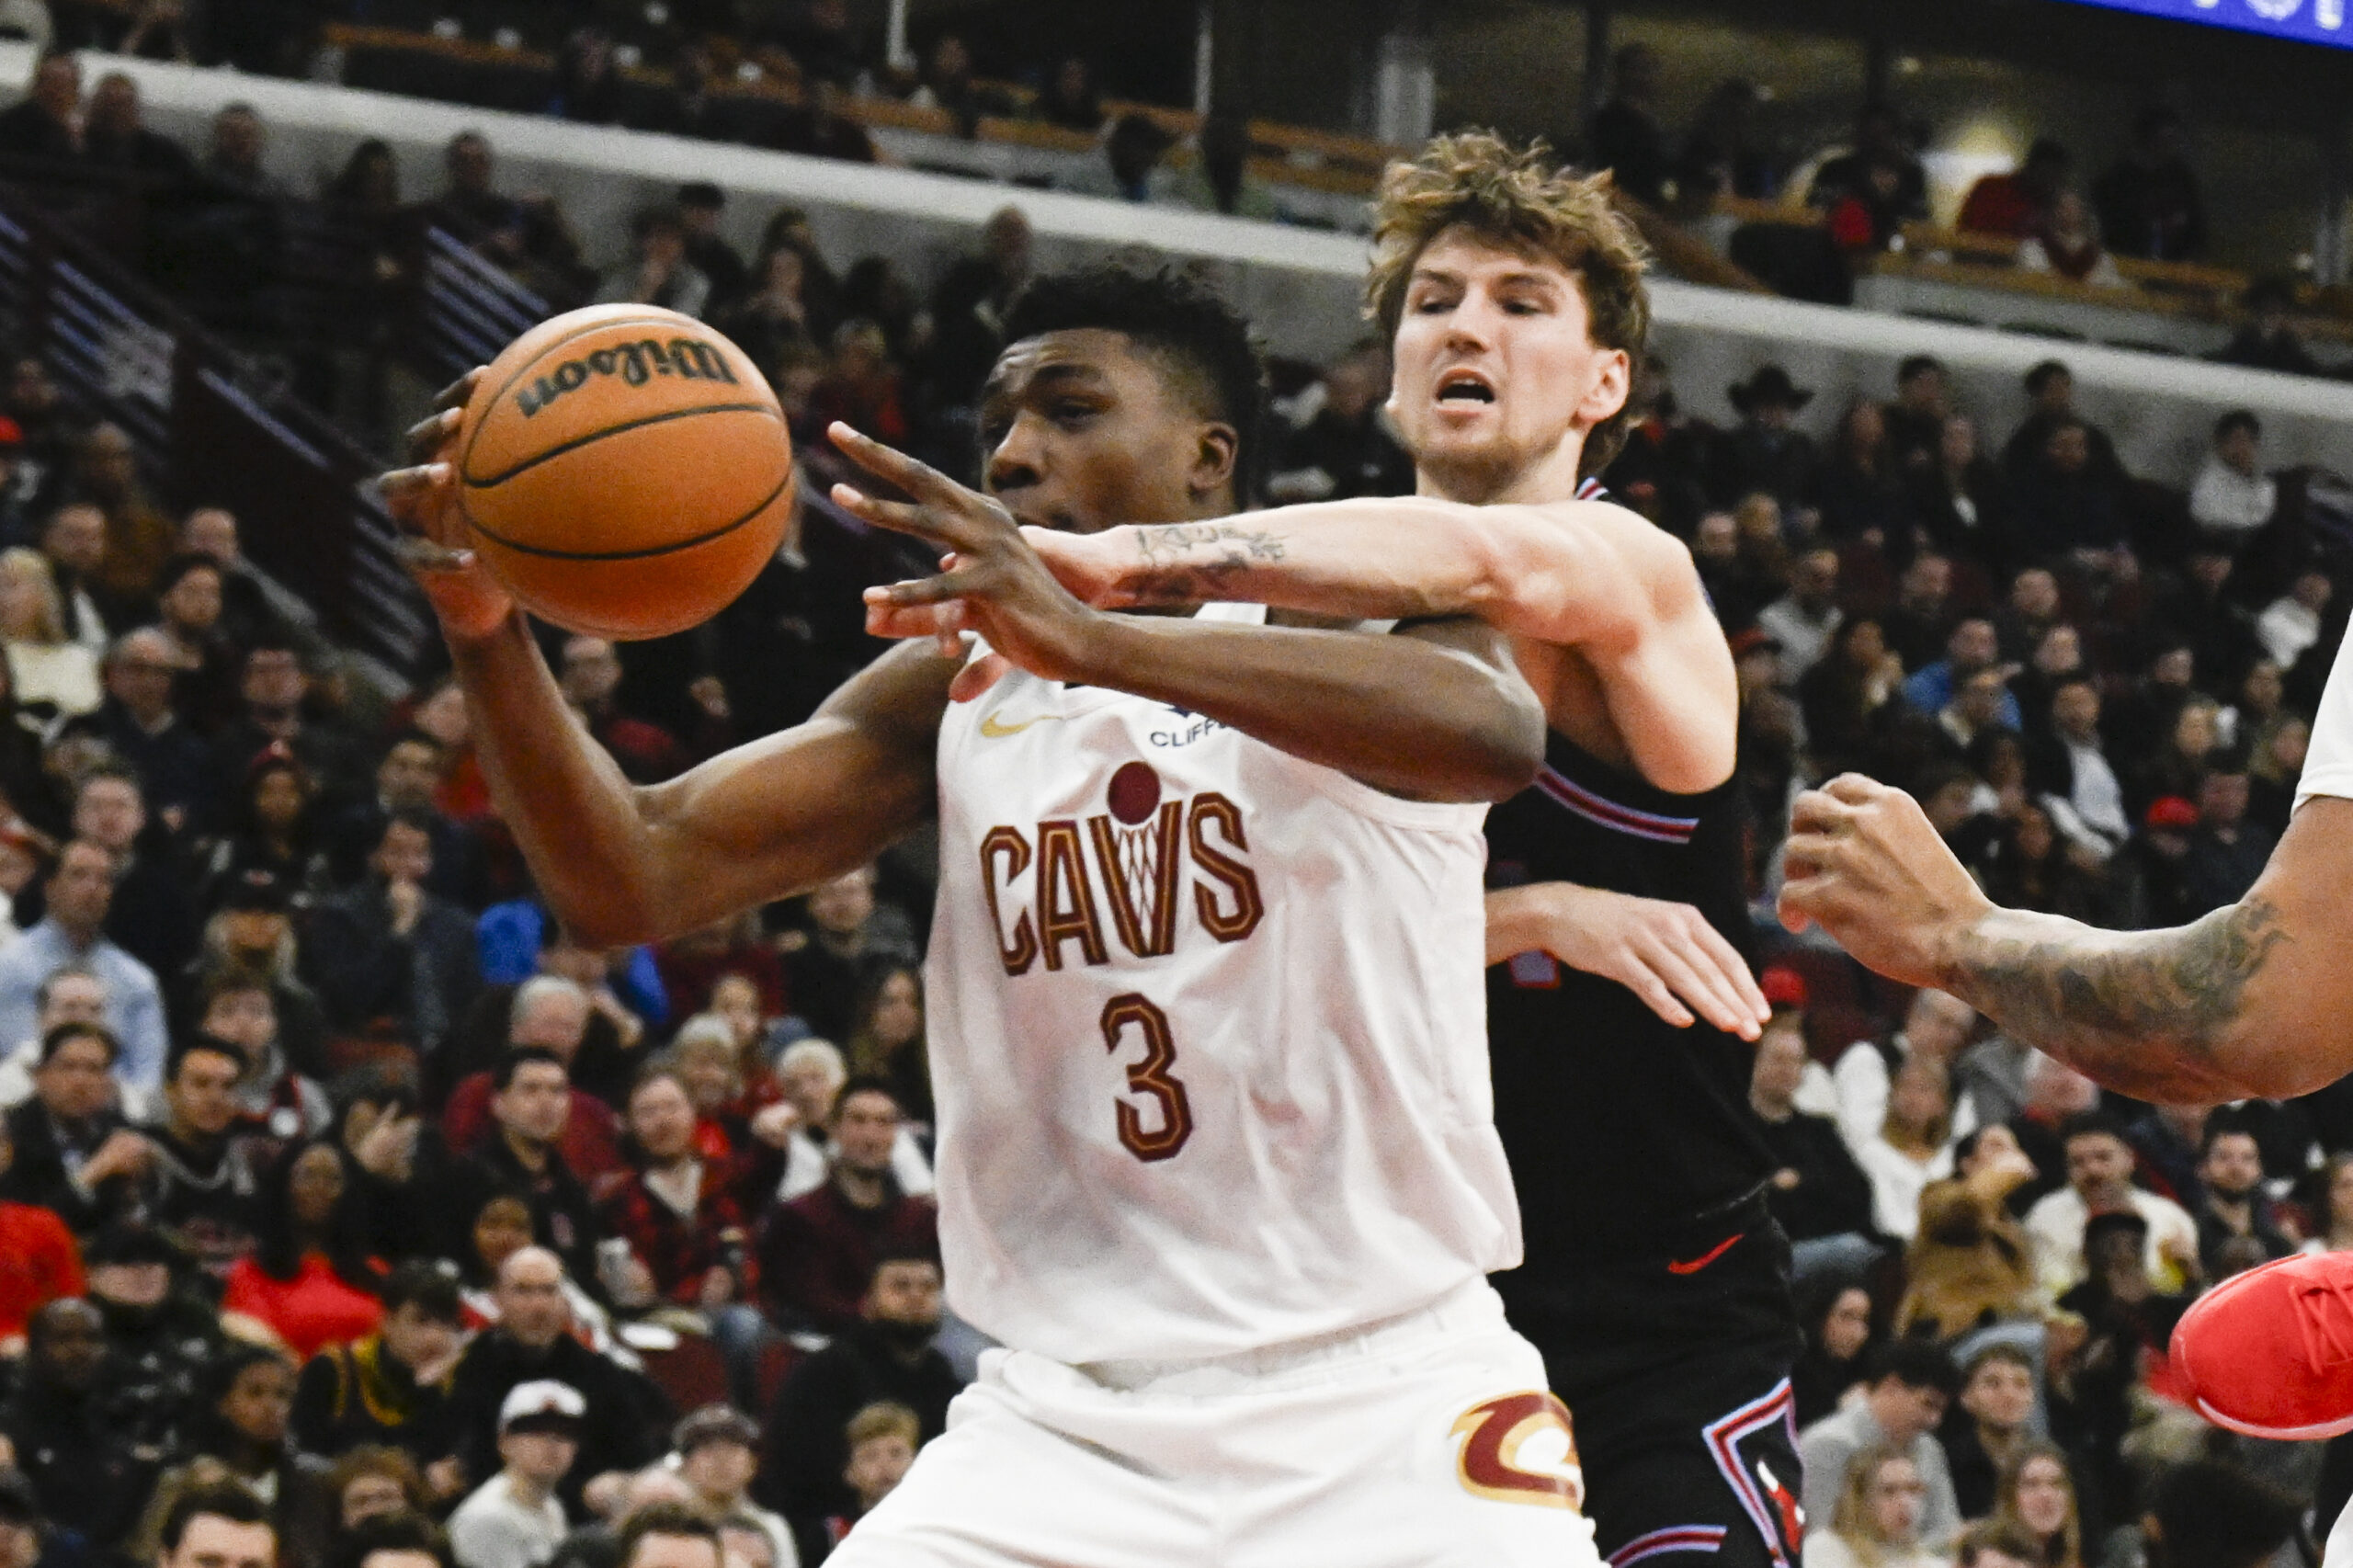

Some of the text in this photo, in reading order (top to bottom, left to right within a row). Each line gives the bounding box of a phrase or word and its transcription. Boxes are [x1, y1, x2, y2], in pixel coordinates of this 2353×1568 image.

[515, 338, 739, 419] Wilson
[1150, 717, 1227, 747] CLIFF
[980, 790, 1265, 977] CAVS
[1100, 992, 1194, 1164] 3
